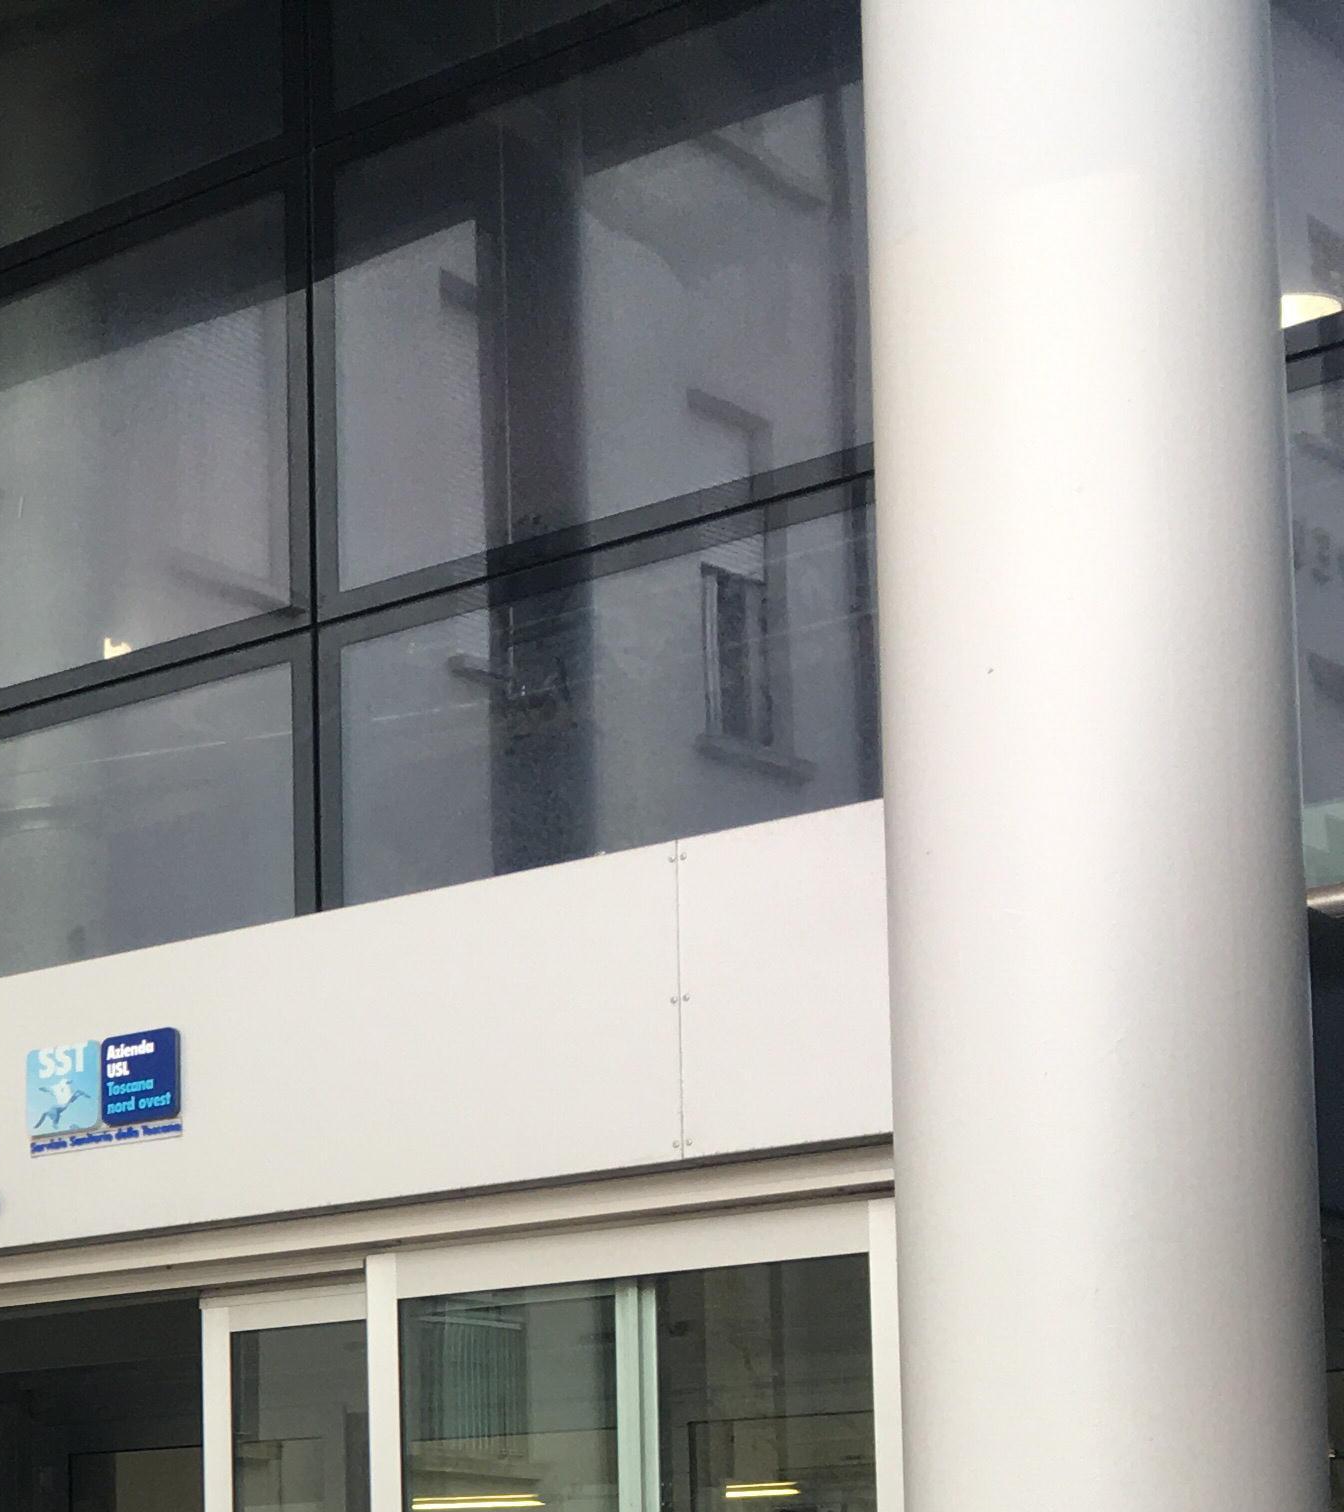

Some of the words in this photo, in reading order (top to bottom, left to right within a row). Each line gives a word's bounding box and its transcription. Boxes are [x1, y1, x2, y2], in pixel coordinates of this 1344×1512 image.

[38, 1040, 89, 1079] SST
[106, 1039, 155, 1061] Azienda
[106, 1061, 130, 1079] USL
[106, 1079, 155, 1097] Toscana
[106, 1096, 136, 1115] nord
[138, 1091, 173, 1111] ovest
